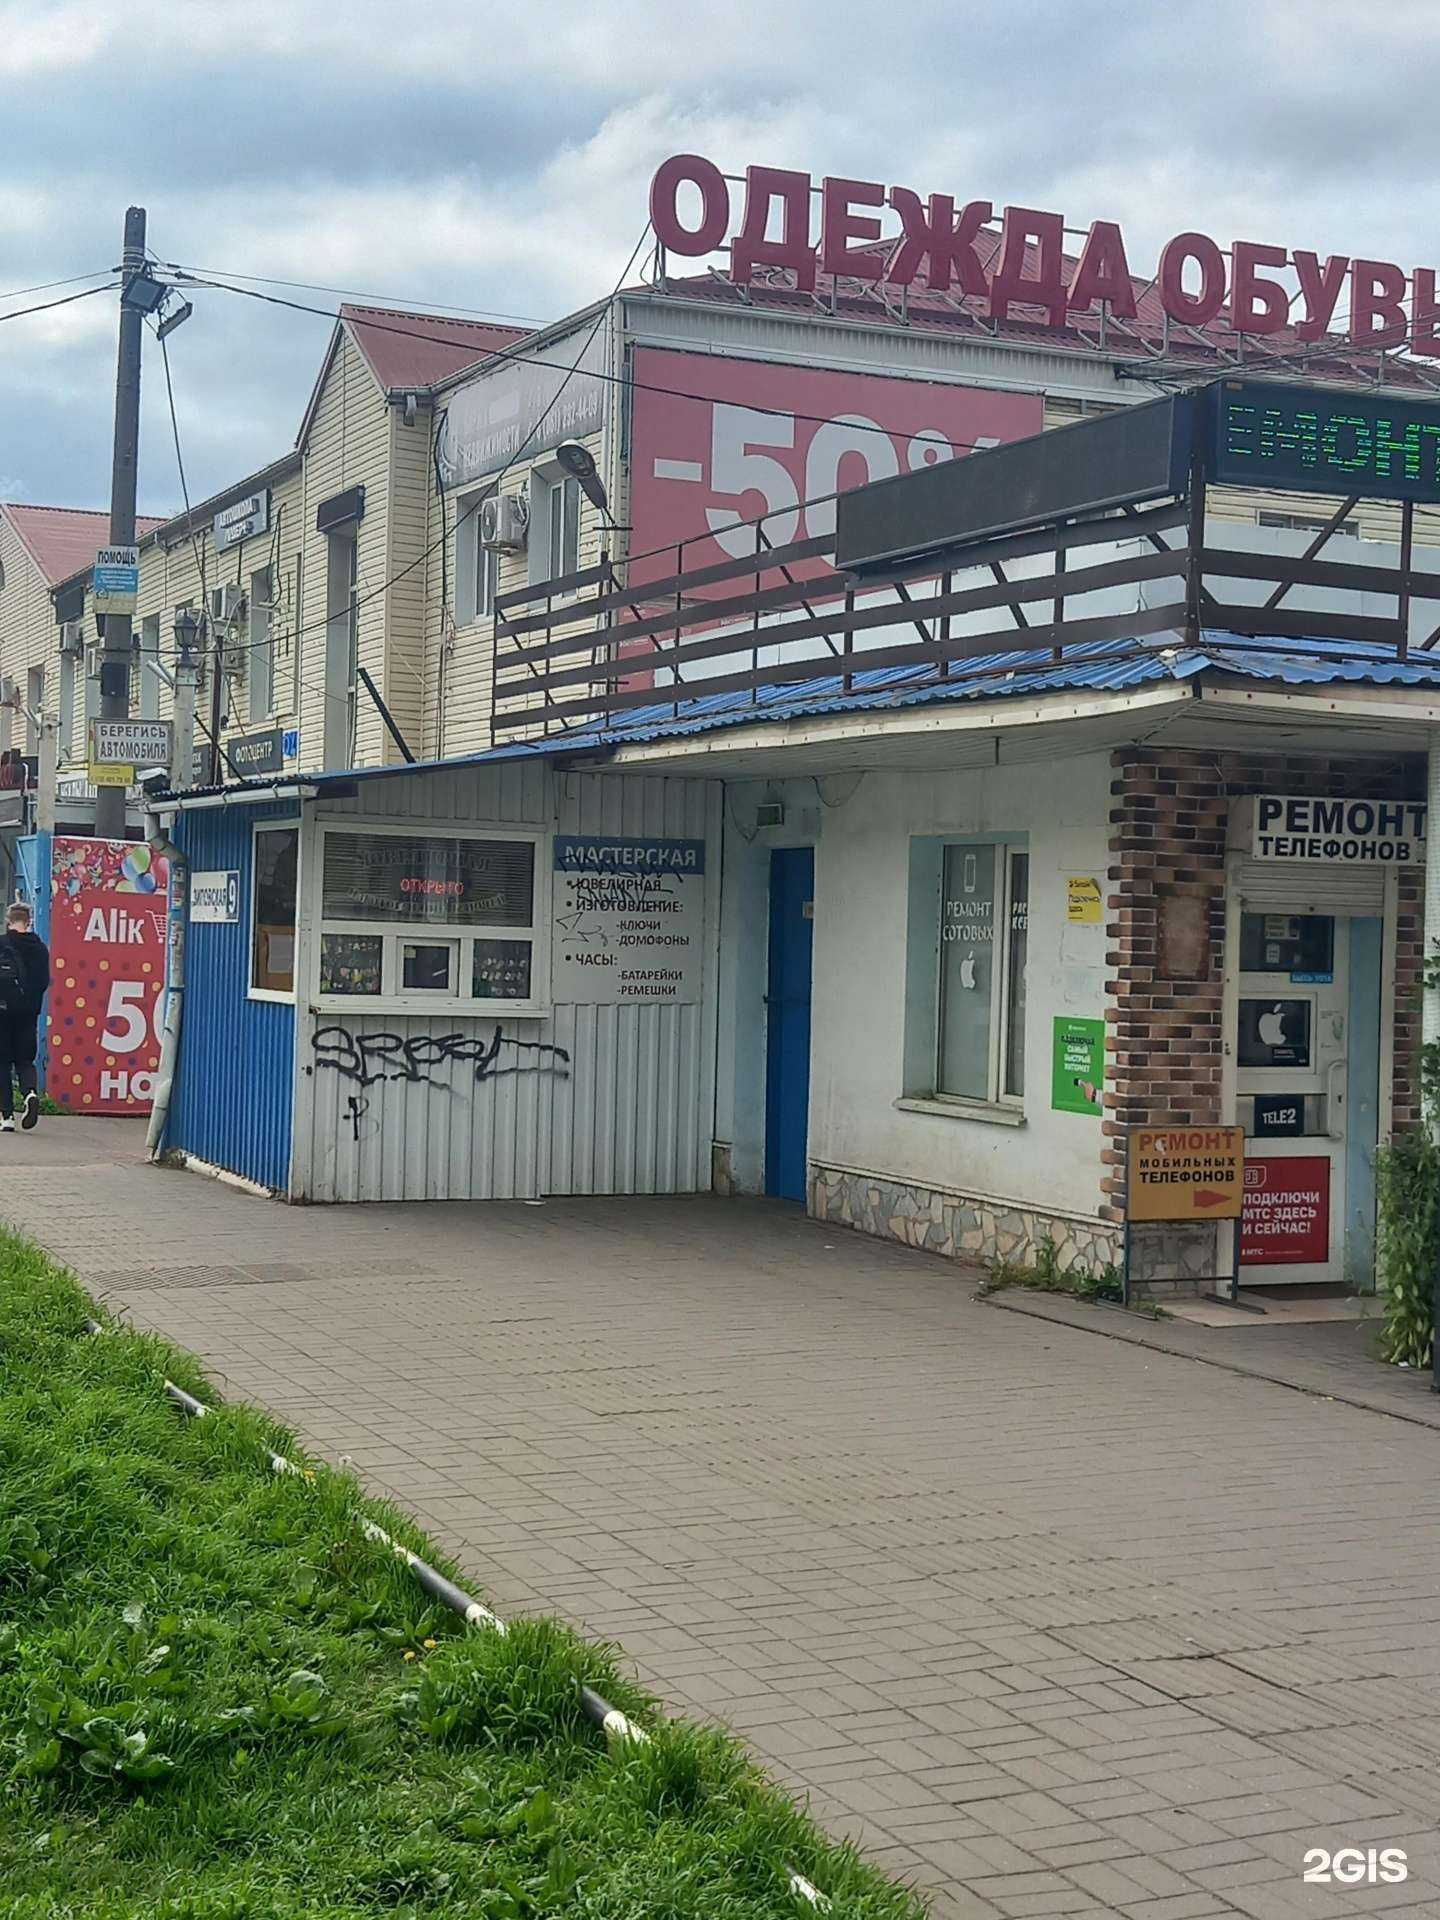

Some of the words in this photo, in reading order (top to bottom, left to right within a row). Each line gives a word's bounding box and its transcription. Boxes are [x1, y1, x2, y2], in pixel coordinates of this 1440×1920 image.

[650, 154, 1137, 326] ОДЕЖДА
[98, 551, 136, 567] ПОМОЩЬ
[100, 726, 166, 738] БЕРЕГИСЬ
[100, 741, 166, 759] АВТОМОБИЛЯ
[1259, 799, 1427, 837] РЕМОНТ
[565, 846, 696, 866] МАСТЕРСКАЯ
[1259, 836, 1410, 861] ТЕЛЕФОНОВ
[576, 878, 661, 891] ЮВЕЛИРНАЯ
[576, 901, 683, 912] ИЗГОТОВЛЕНИЕ:
[947, 901, 991, 917] РЕМОНТ
[943, 925, 993, 940] СОТОВЫХ
[575, 954, 618, 966] ЧАСЫ:
[1262, 1107, 1297, 1125] TELE2
[1139, 1131, 1236, 1151] РЕМОНТ
[1139, 1157, 1236, 1169] МОБИЛЬНЫХ
[1139, 1170, 1235, 1183] ТЕЛЕФОНОВ
[1243, 1191, 1320, 1207] ПОДКЛЮЧИ
[1243, 1207, 1271, 1220] МТС
[1275, 1206, 1317, 1220] ЗДЕСЬ
[1242, 1223, 1252, 1235] И
[1255, 1220, 1310, 1235] СЕЙЧАС!
